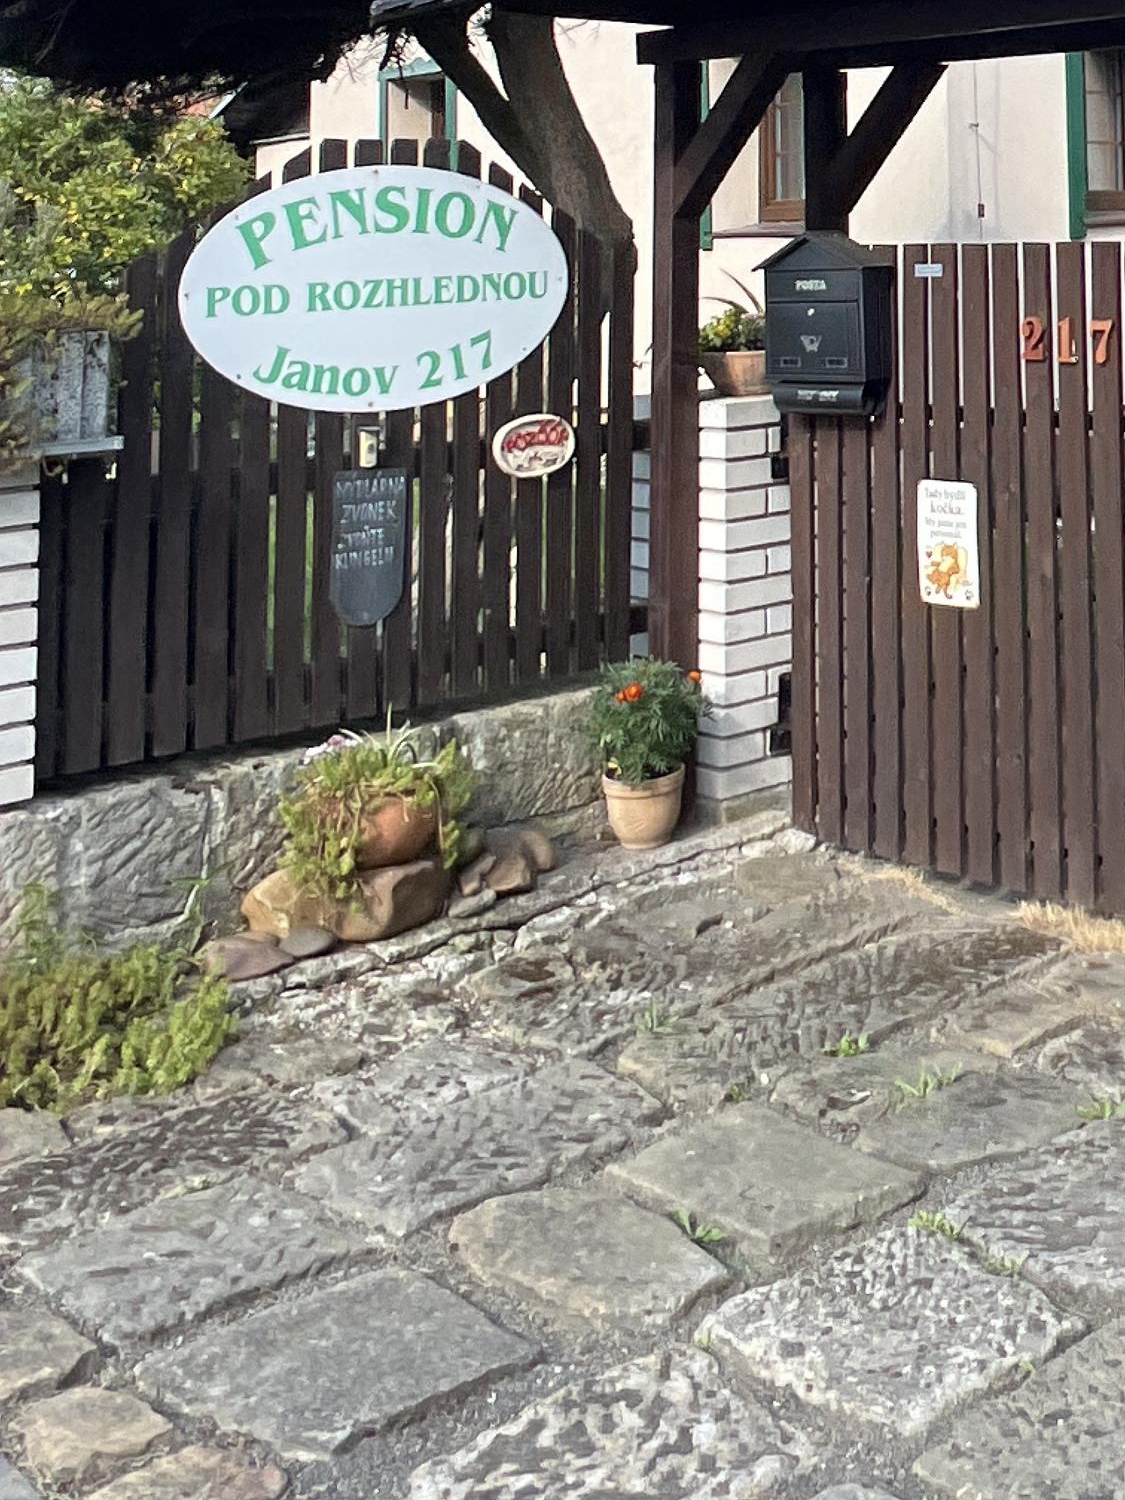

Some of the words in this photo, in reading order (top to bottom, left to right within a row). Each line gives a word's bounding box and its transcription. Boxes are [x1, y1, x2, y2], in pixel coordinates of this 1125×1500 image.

[235, 185, 518, 271] PENSION
[206, 285, 289, 318] POD
[306, 271, 549, 313] ROZHLEDNOU
[252, 345, 399, 396] Janov
[416, 330, 493, 390] 217
[1022, 315, 1114, 364] 217
[340, 501, 398, 524] ZVONEK
